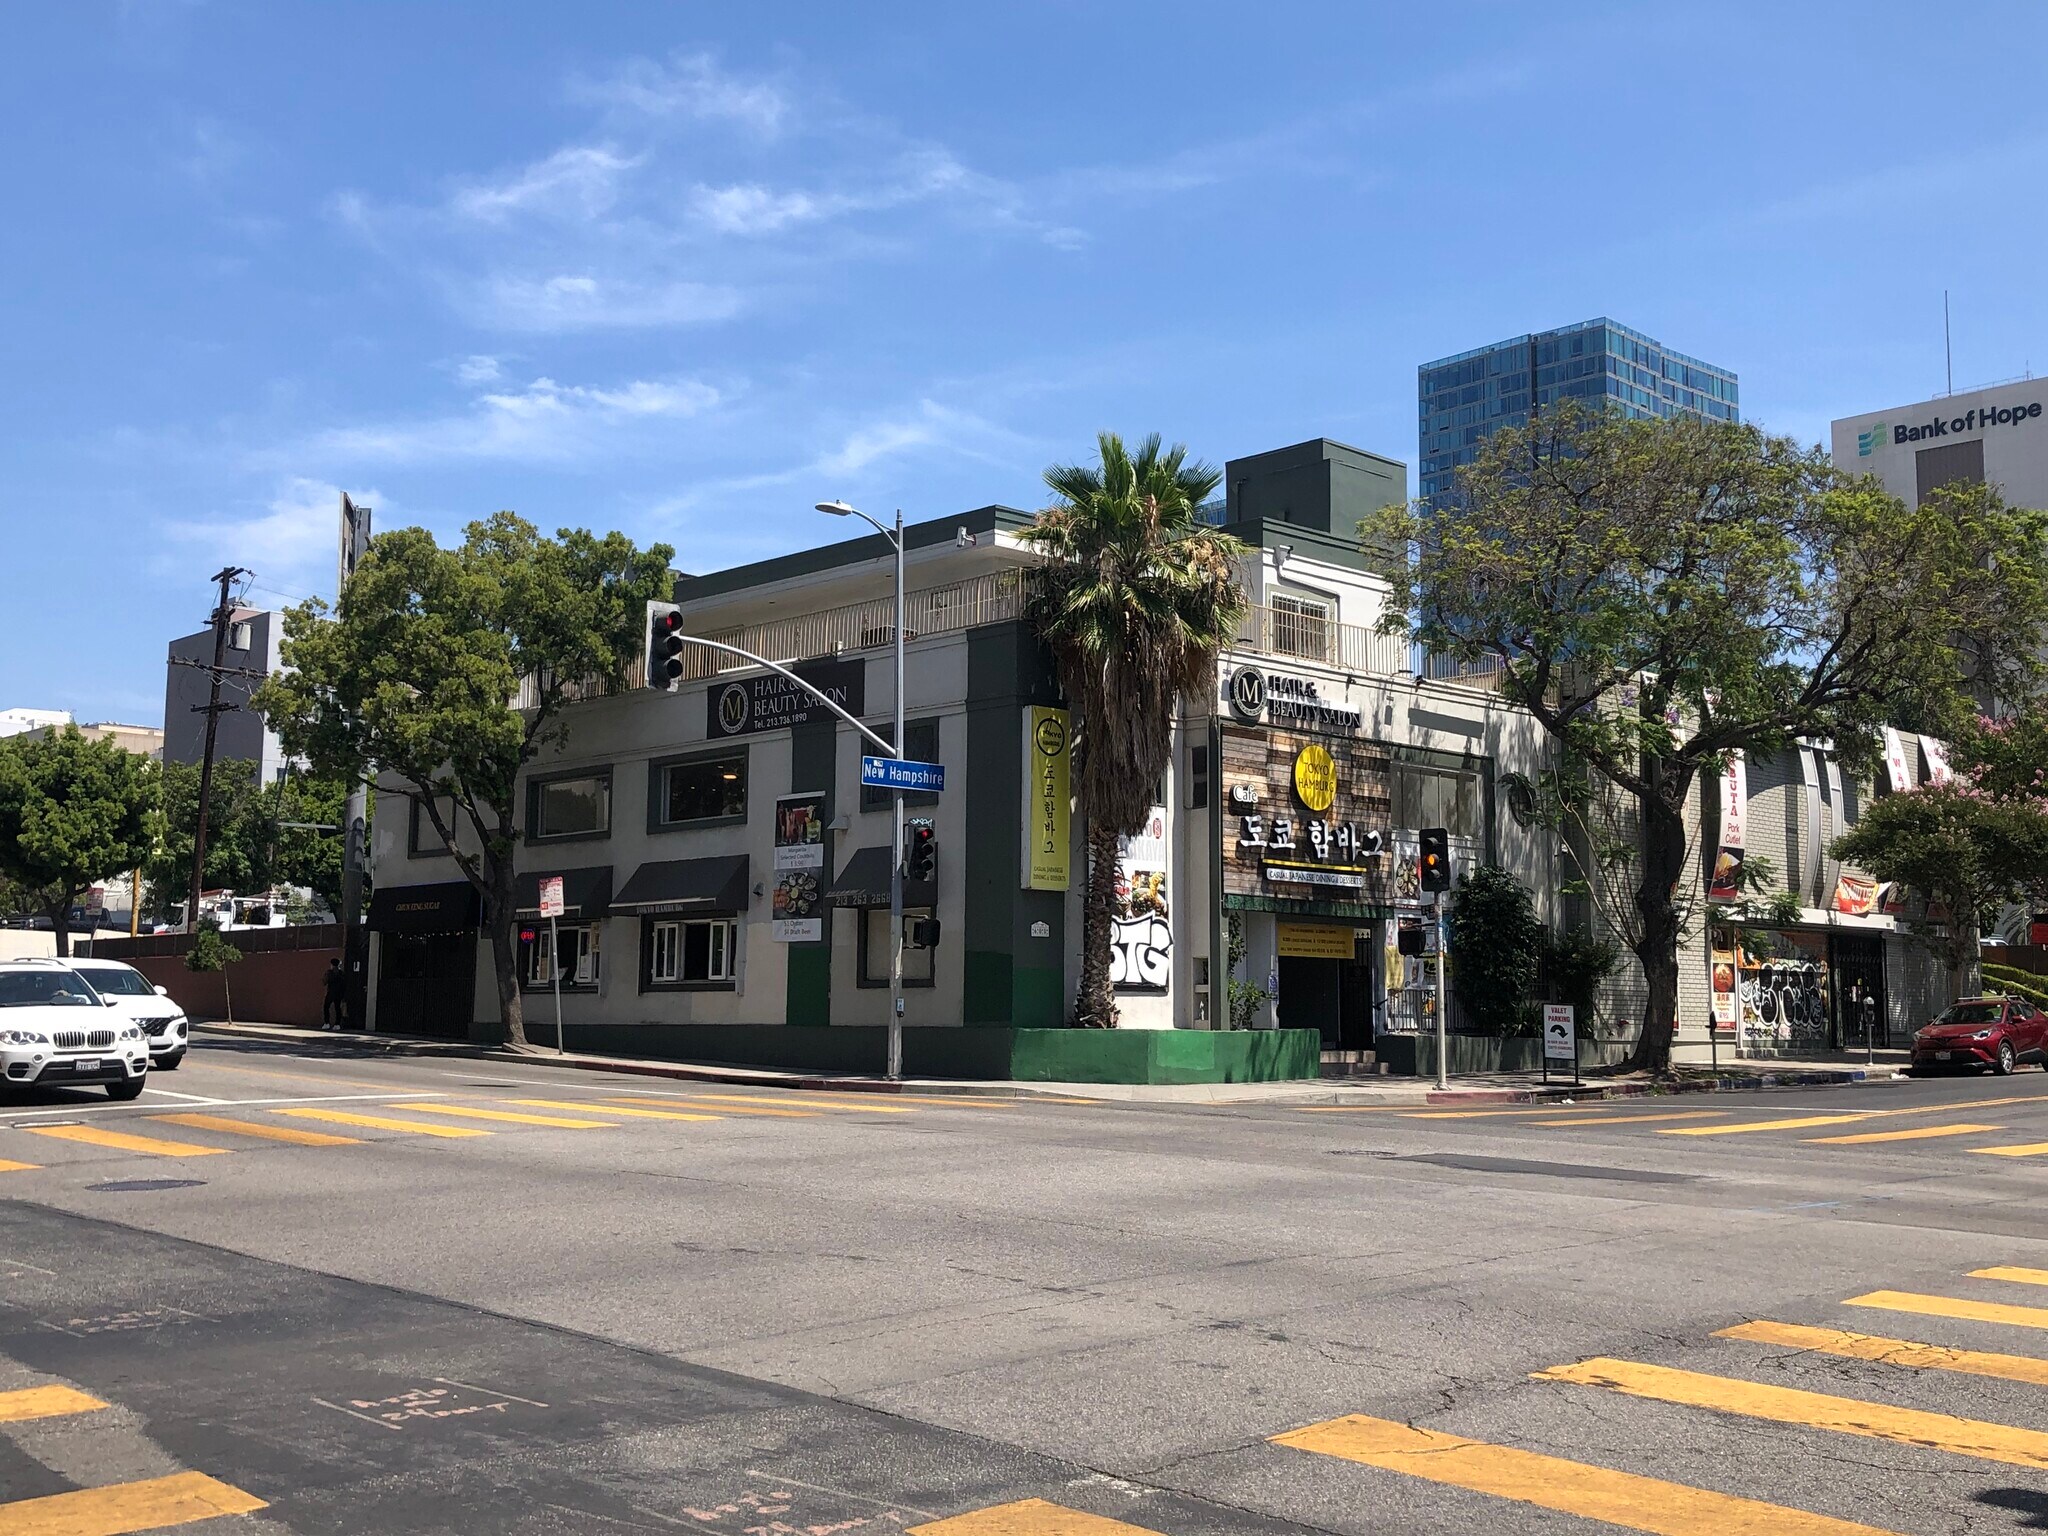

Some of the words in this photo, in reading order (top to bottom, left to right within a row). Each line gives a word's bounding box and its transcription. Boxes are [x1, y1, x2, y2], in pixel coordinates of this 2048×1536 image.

[1894, 417, 1948, 444] Bank
[1950, 410, 1975, 433] of
[1979, 402, 2042, 427] Hope
[754, 677, 786, 697] HAIR
[1272, 676, 1306, 696] HAIR
[1305, 682, 1319, 698] &
[754, 693, 800, 717] BEAUTY
[1272, 700, 1319, 720] BEAUTY
[1322, 708, 1361, 728] SALON
[754, 720, 765, 729] Tel.
[864, 763, 886, 779] New
[889, 766, 943, 786] Hampshire
[1303, 762, 1329, 776] TOKYO
[1298, 777, 1334, 792] HAMBURG
[1728, 822, 1740, 833] Pork
[1240, 814, 1297, 849] 도쿄
[1308, 818, 1385, 862] 함바그
[1269, 869, 1289, 880] CASUAL
[1289, 871, 1316, 883] JAPANESE
[1316, 874, 1335, 884] DINING
[1339, 875, 1363, 886] DESSERTS
[835, 896, 848, 906] 213
[852, 895, 867, 905] 263
